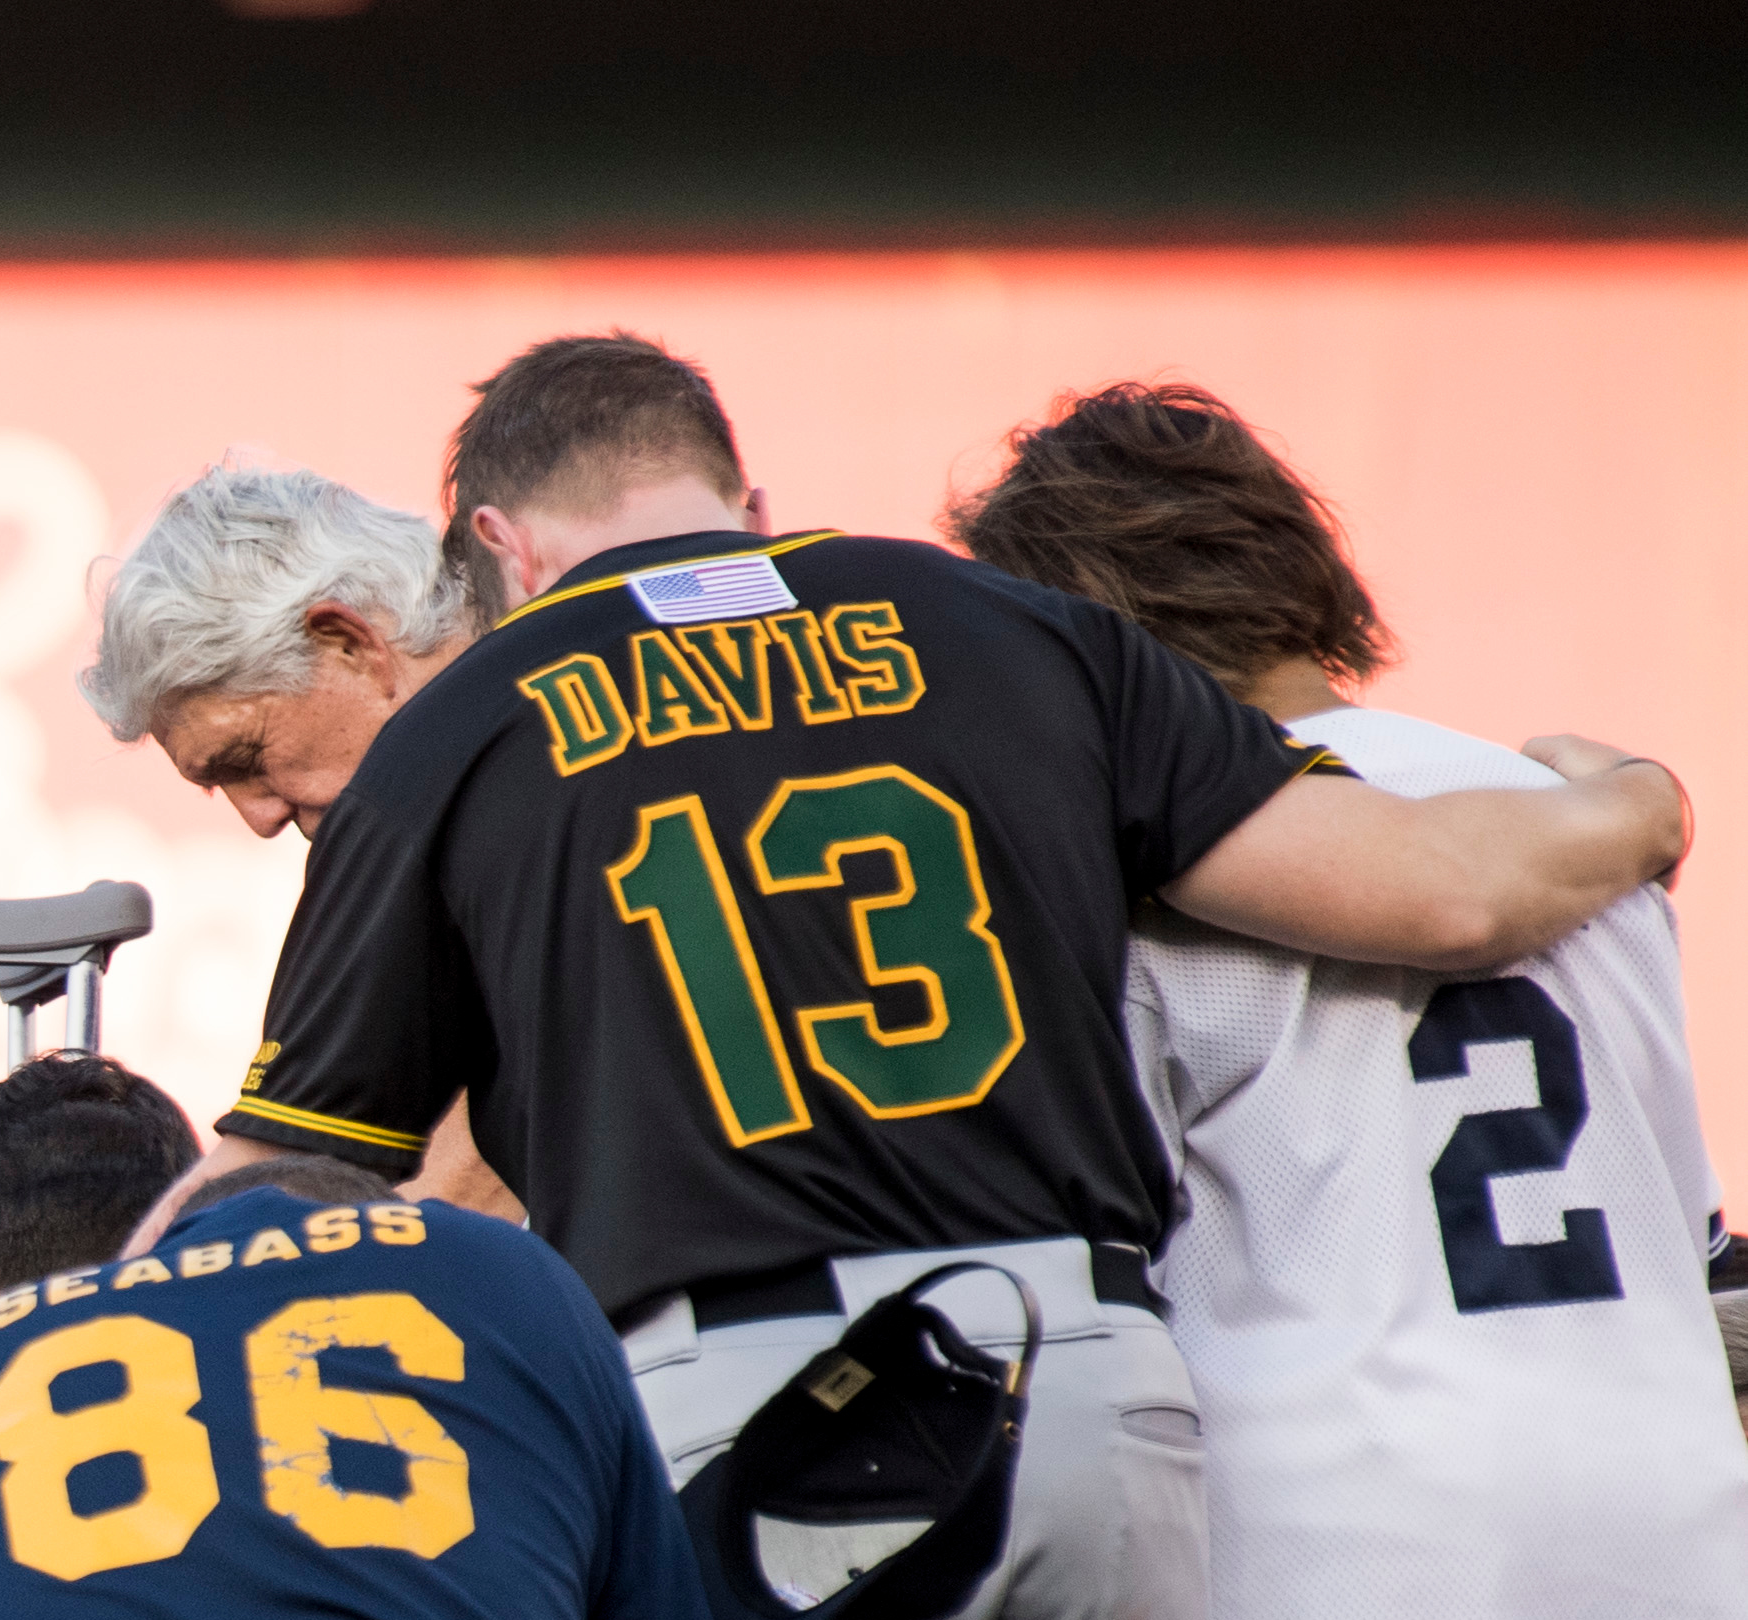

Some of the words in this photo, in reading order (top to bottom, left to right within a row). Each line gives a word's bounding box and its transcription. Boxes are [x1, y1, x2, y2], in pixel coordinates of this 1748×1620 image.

[518, 602, 927, 777] DAVIS
[607, 764, 1026, 1148] 13
[1408, 976, 1626, 1315] 2
